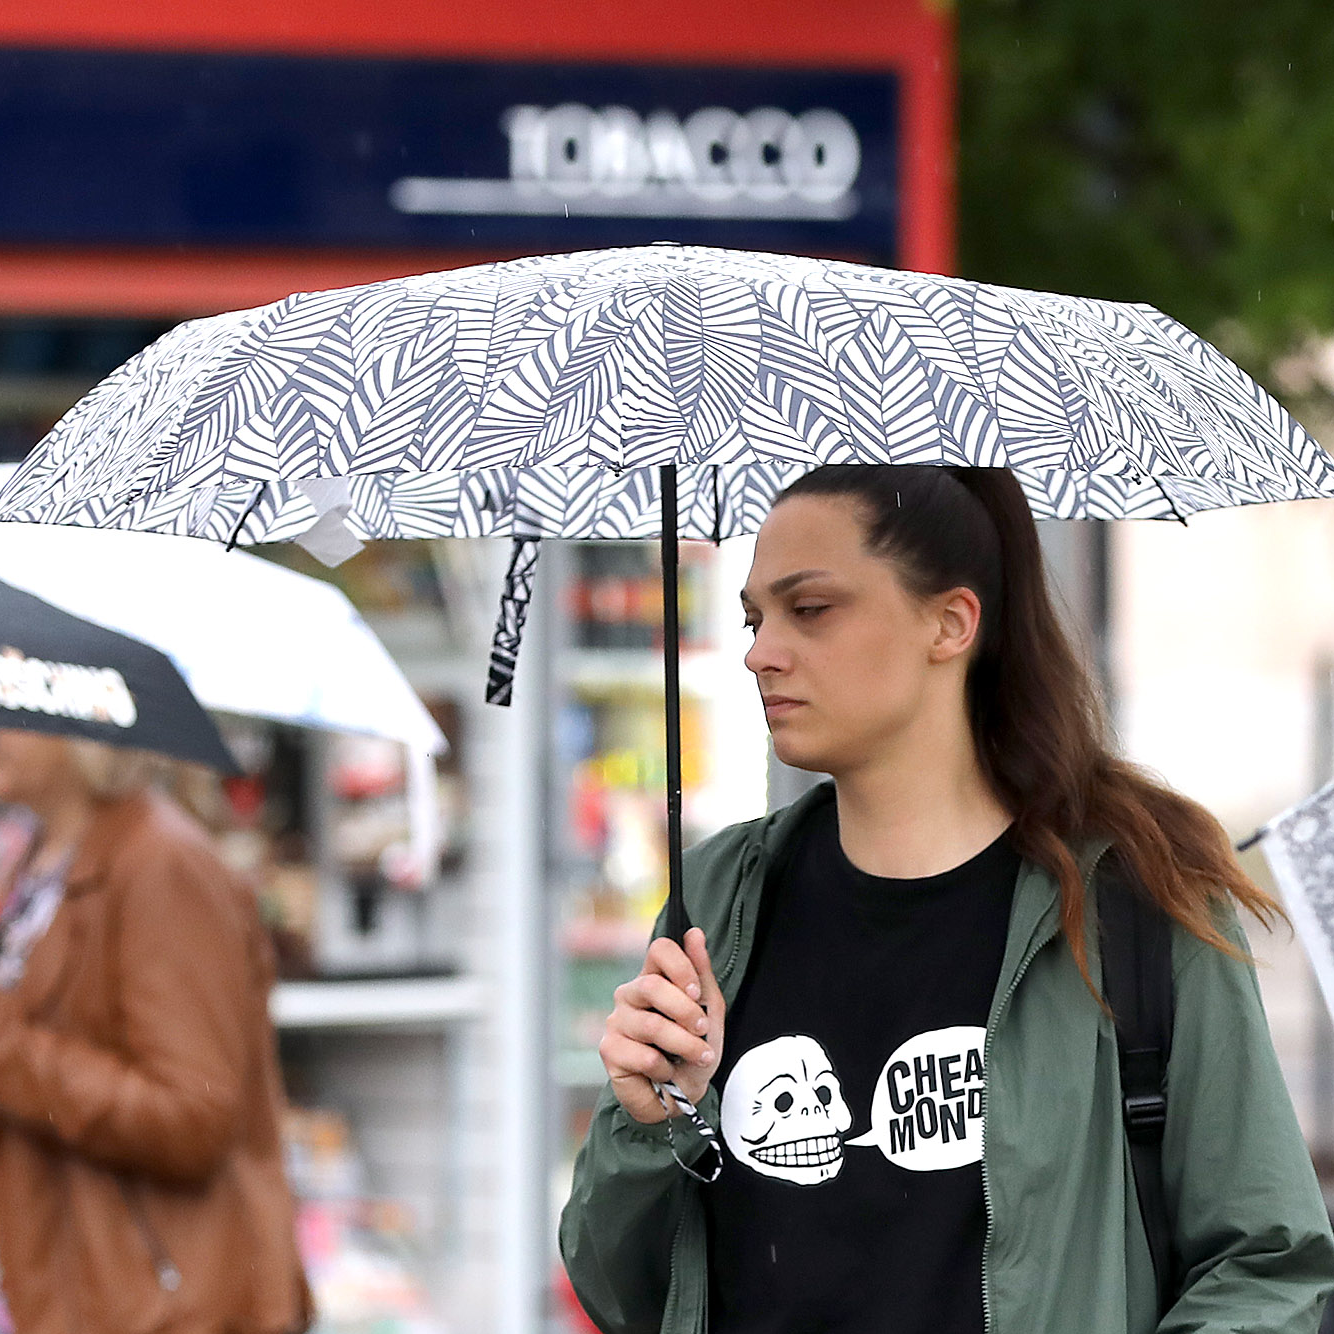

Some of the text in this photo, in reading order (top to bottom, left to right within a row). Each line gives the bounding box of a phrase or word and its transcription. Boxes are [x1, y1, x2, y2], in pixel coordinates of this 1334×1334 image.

[504, 104, 860, 201] TOBACCO
[887, 1048, 985, 1115] CHEA
[889, 1088, 984, 1155] MOND
